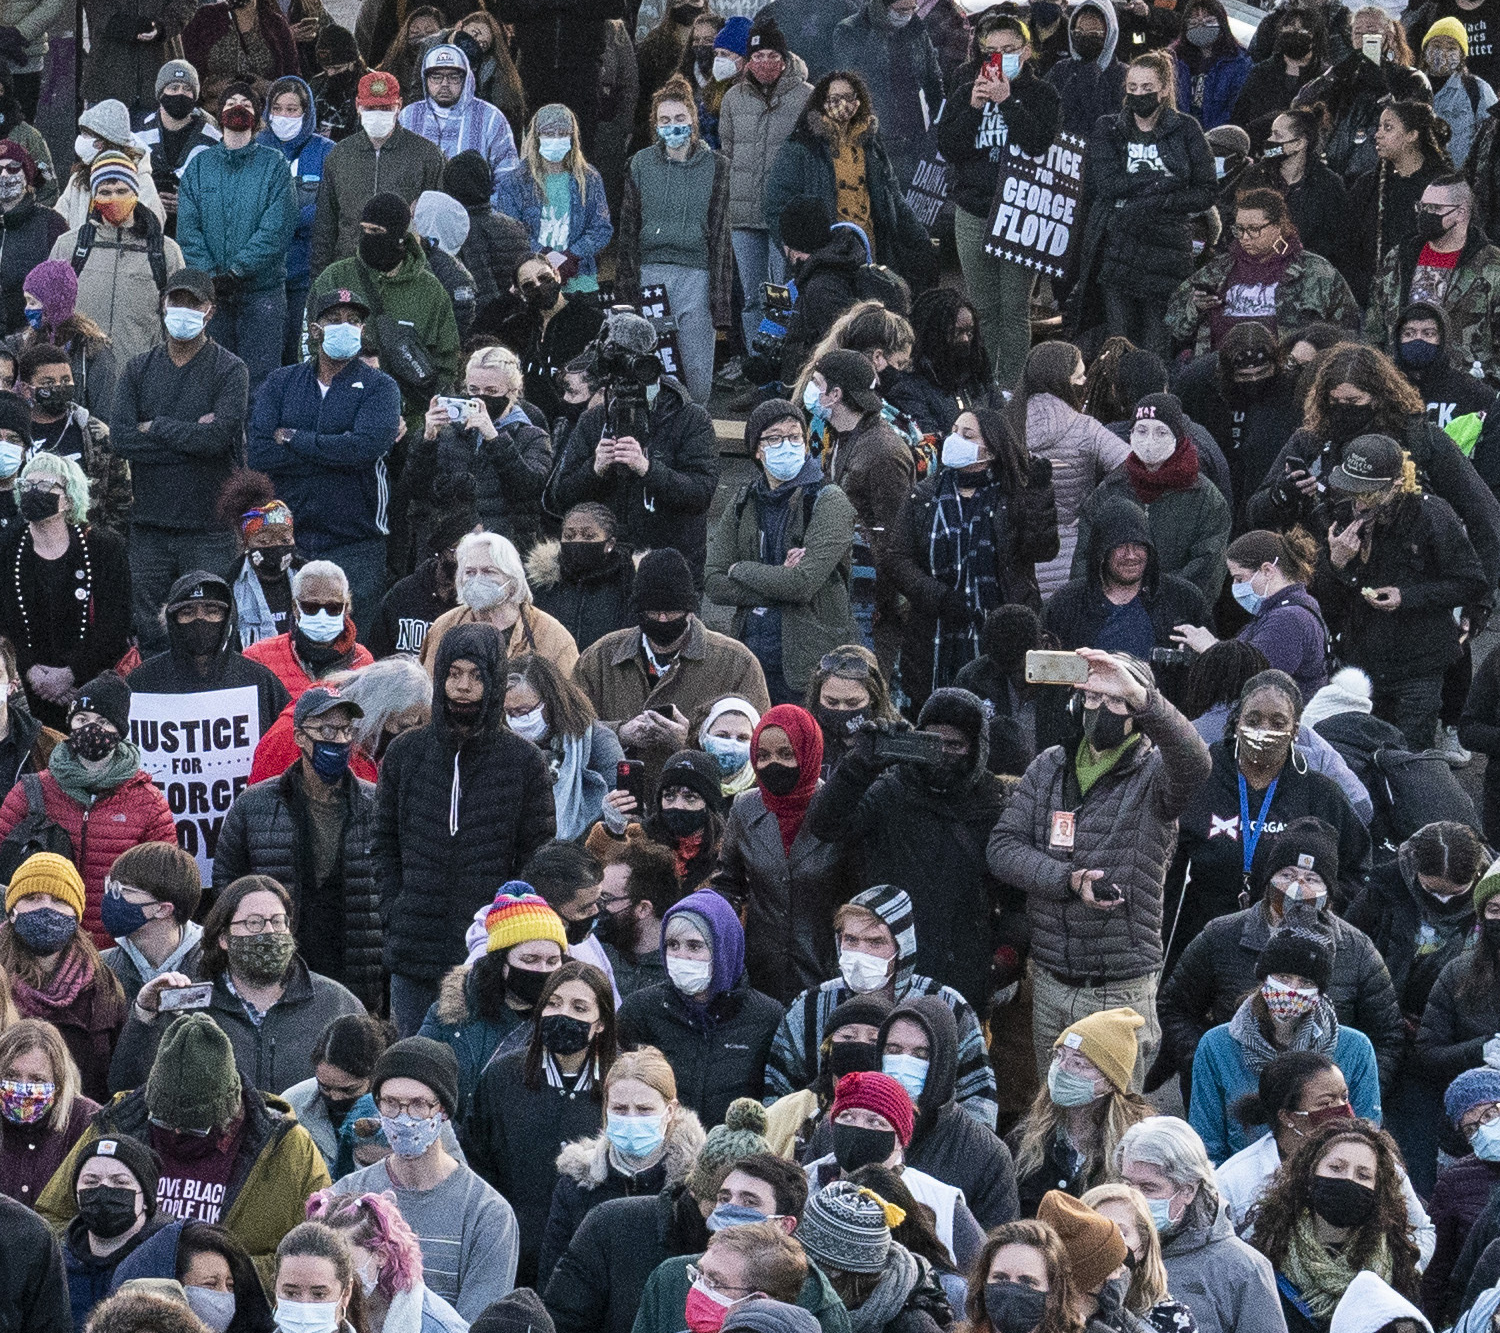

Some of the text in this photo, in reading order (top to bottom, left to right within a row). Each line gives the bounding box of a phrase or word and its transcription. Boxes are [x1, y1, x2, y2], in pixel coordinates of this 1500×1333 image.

[1002, 176, 1077, 226] GEORGE
[991, 203, 1070, 258] FLOYD
[171, 758, 202, 775] FOR
